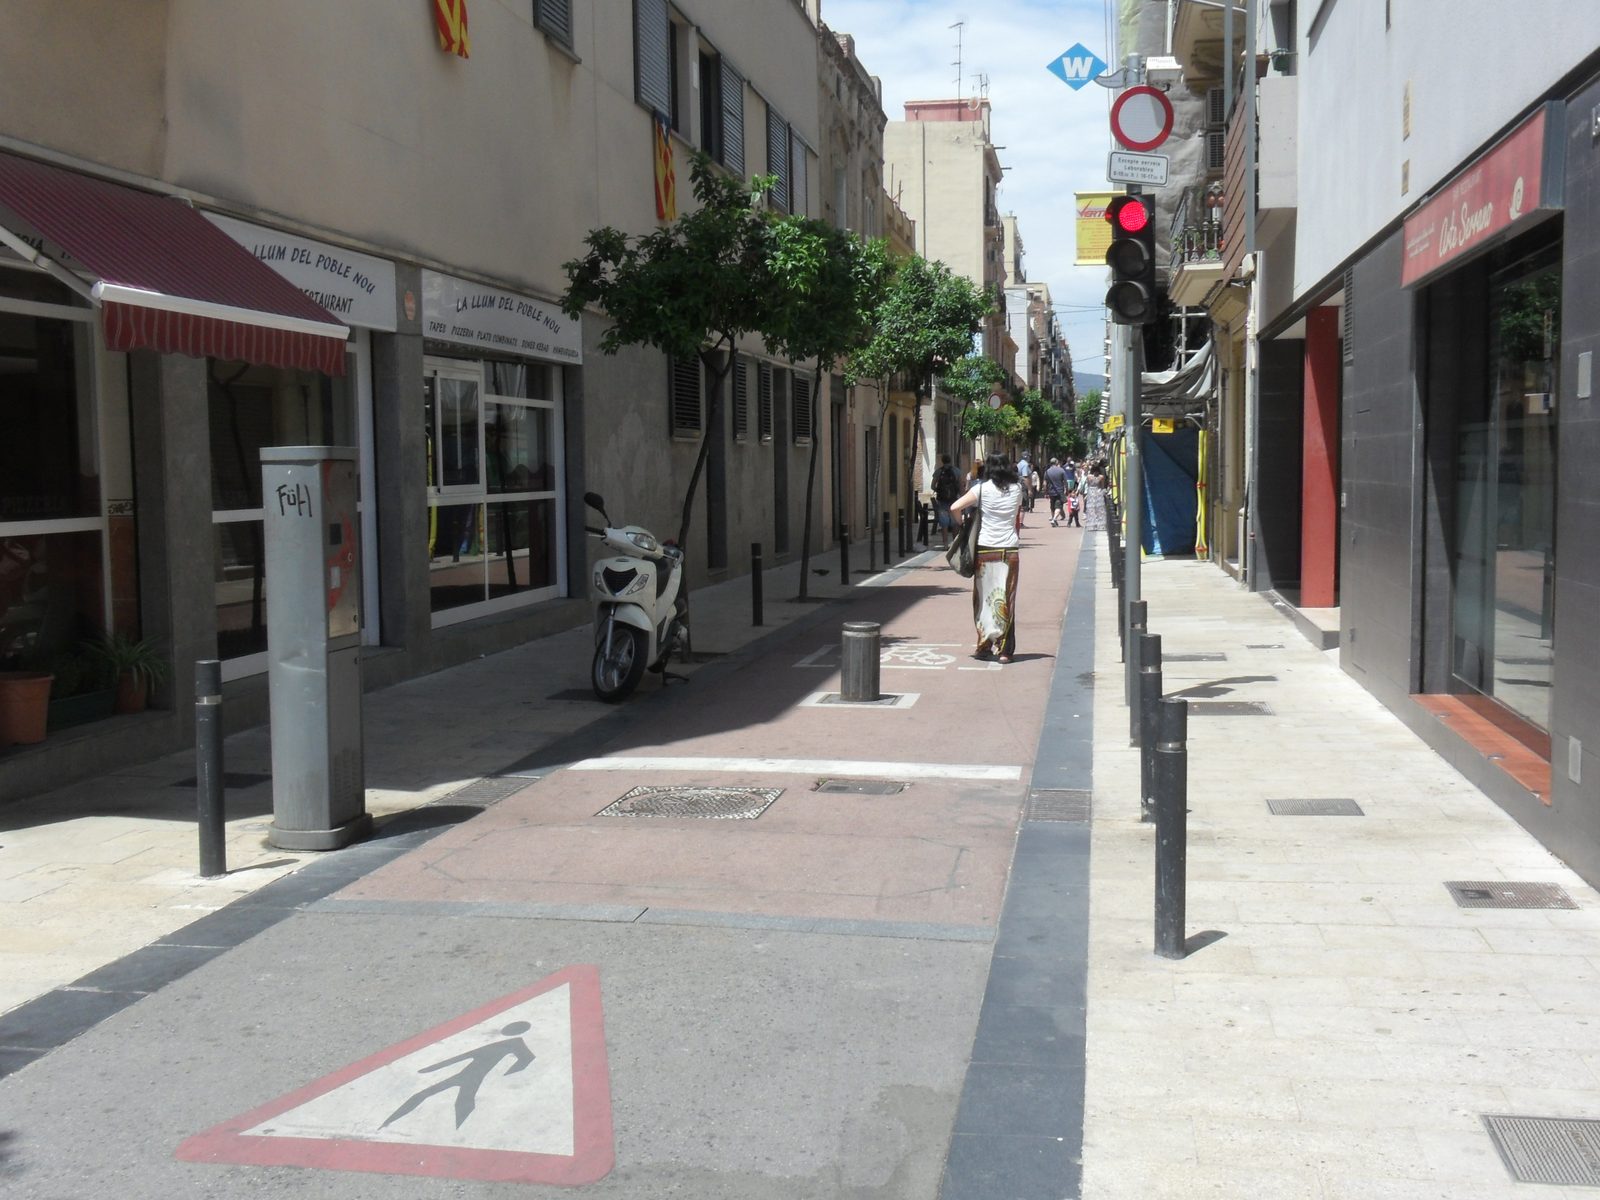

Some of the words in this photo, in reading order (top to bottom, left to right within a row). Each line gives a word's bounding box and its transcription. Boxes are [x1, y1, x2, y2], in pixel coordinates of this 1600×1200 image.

[1062, 57, 1094, 78] W
[290, 247, 312, 265] DEL
[315, 254, 352, 278] POBLE
[352, 272, 376, 295] NOU
[300, 288, 354, 314] TAURANT
[456, 296, 468, 313] LA
[471, 295, 496, 309] LLUM
[498, 296, 514, 311] DEL
[516, 301, 543, 322] POBLE
[543, 315, 561, 335] NOU
[451, 325, 474, 339] PIZZERIA
